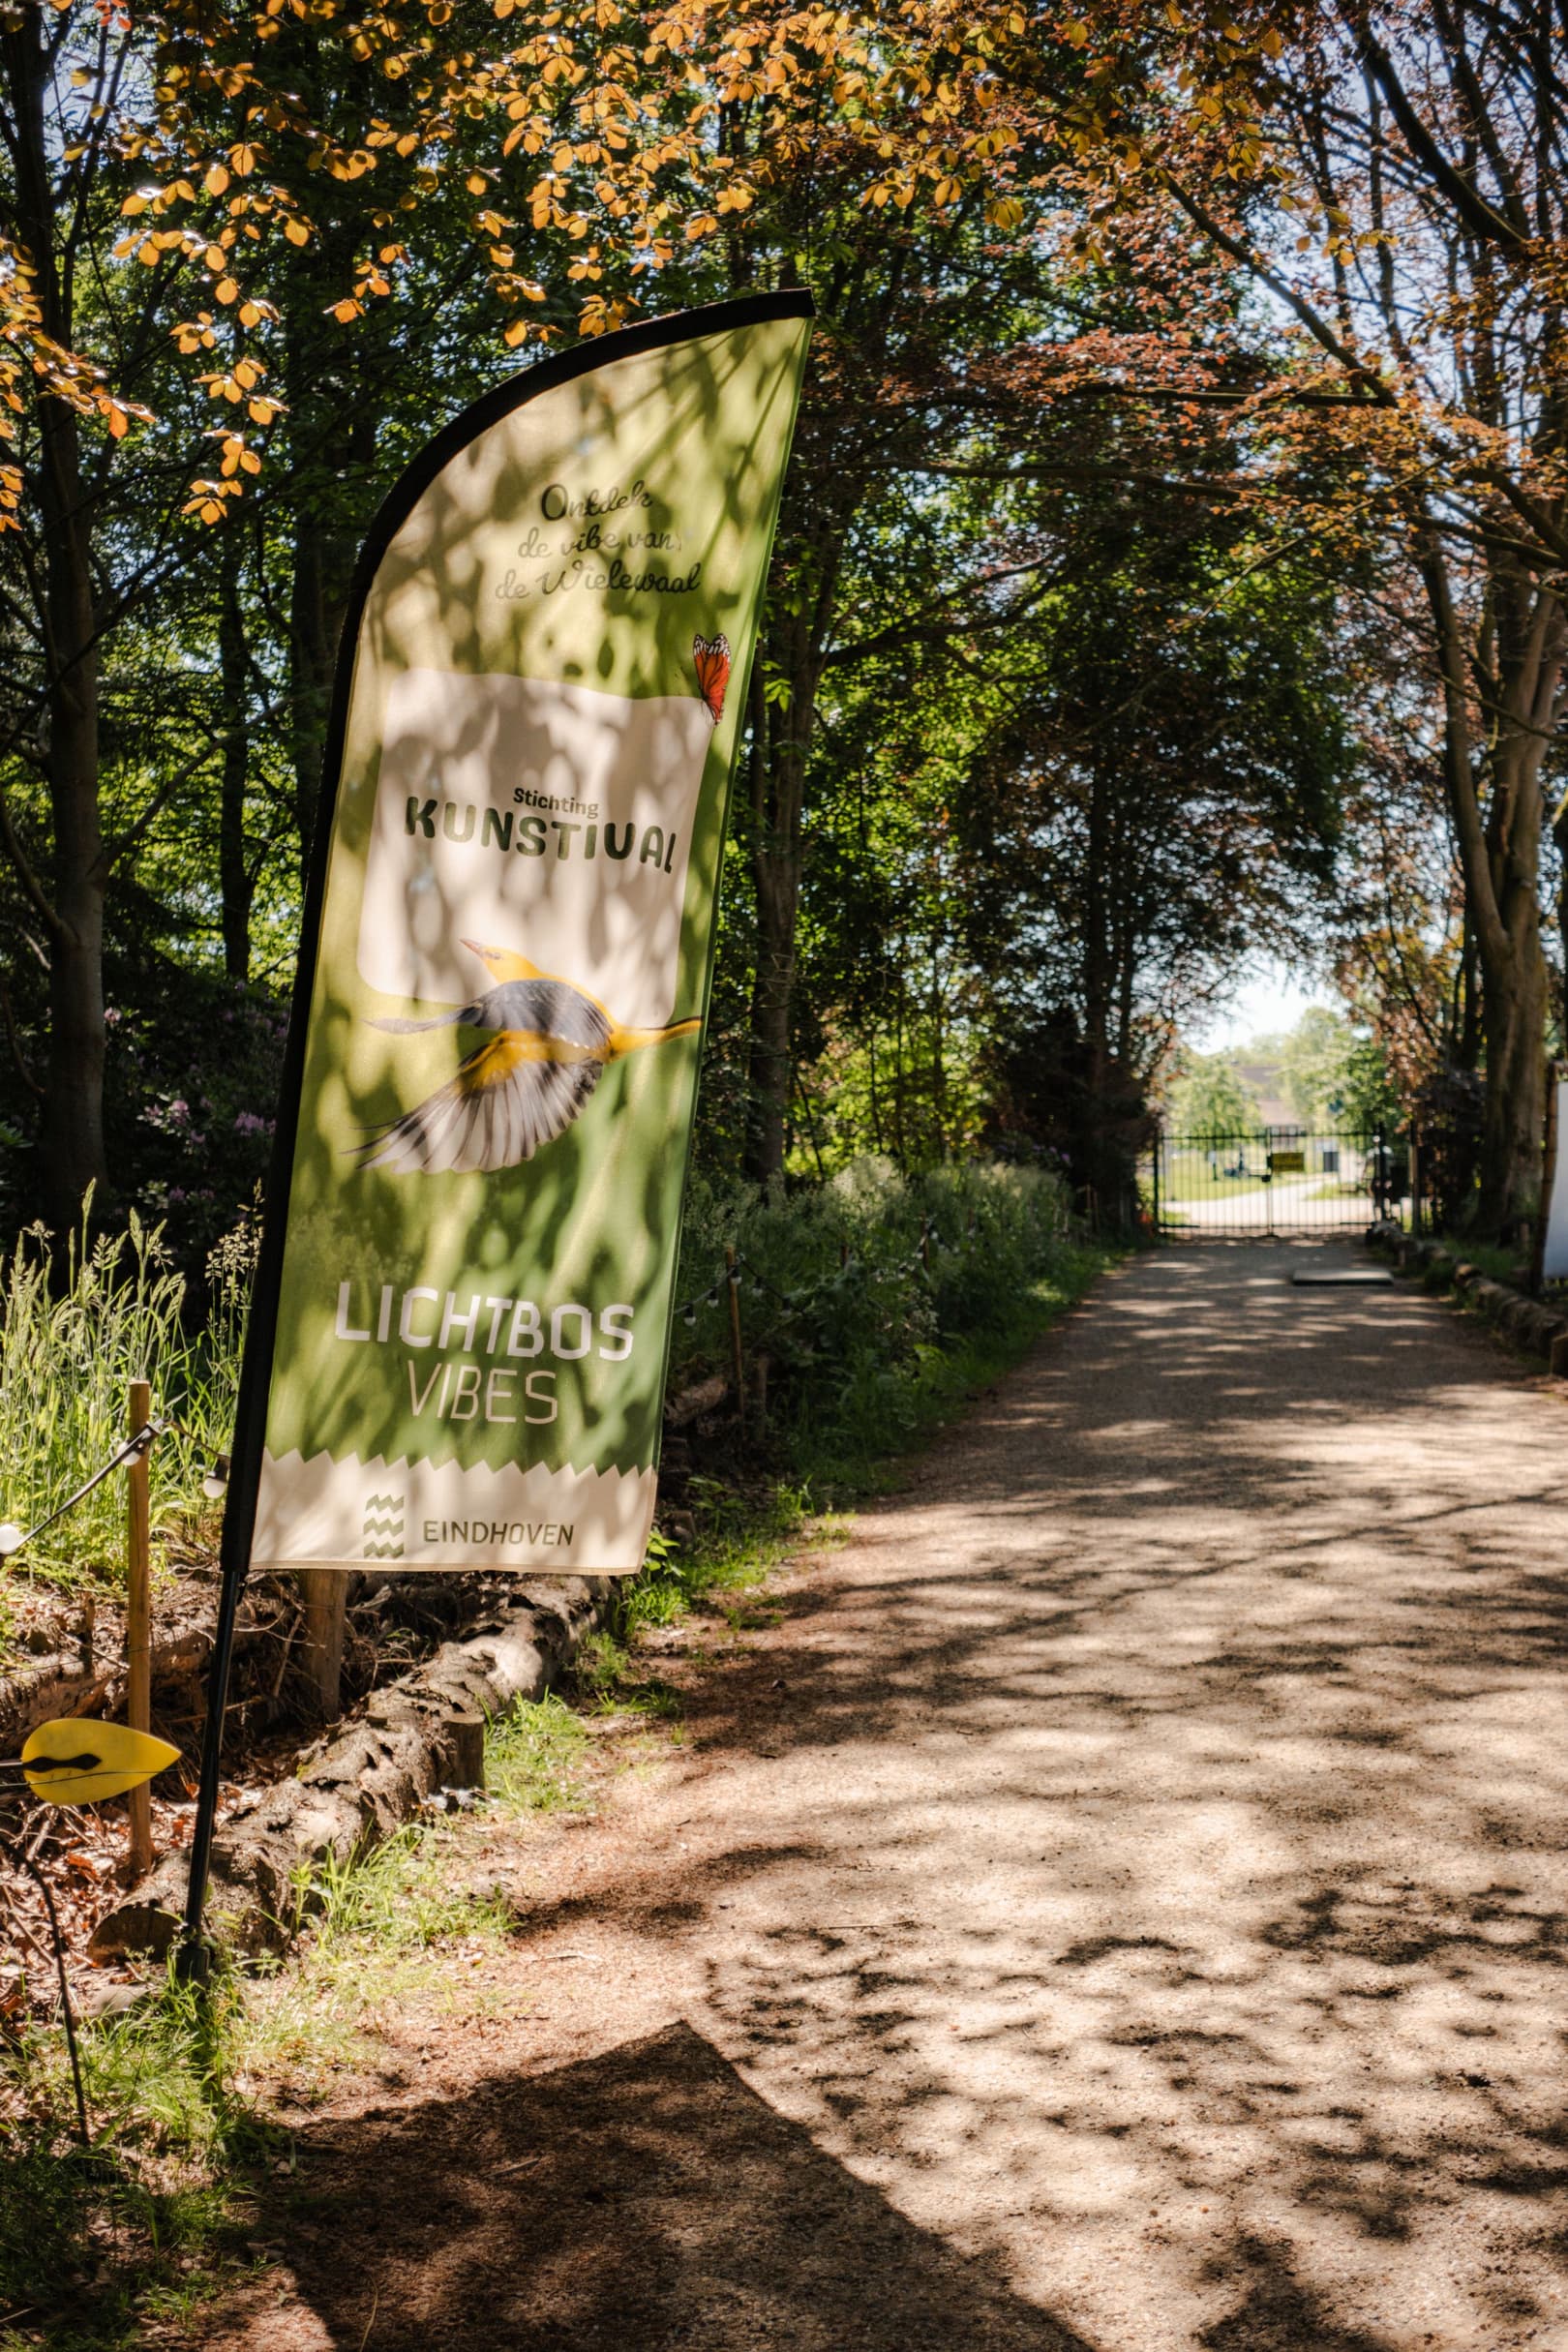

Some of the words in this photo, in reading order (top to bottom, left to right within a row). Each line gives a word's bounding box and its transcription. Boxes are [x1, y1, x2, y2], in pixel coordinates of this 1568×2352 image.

[540, 479, 653, 521] Ontdek
[517, 527, 552, 558] de
[560, 524, 620, 556] vibe
[495, 569, 531, 599] de
[534, 558, 702, 595] Wielewaal
[513, 787, 600, 819] Stichting
[335, 1282, 635, 1362] LICHTBOS
[407, 1360, 558, 1425] VIBES
[423, 1520, 575, 1547] EINDHOVEN
